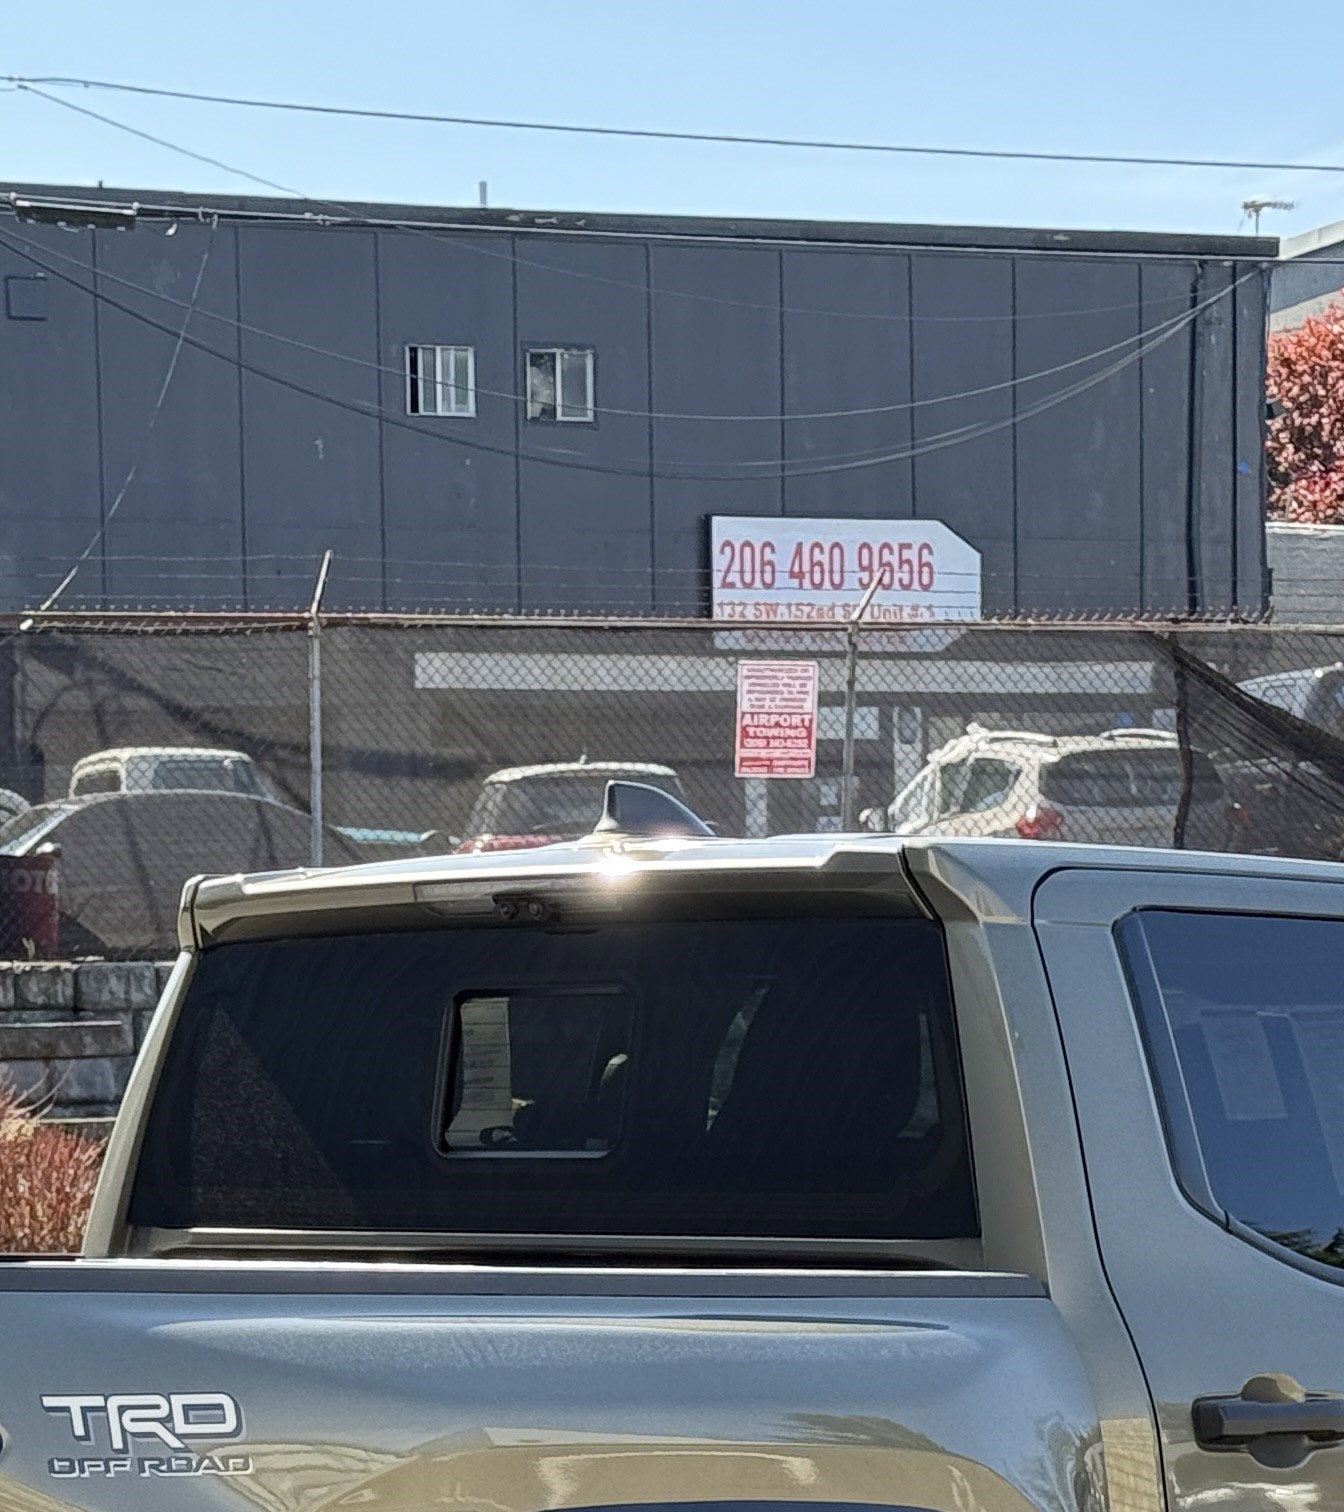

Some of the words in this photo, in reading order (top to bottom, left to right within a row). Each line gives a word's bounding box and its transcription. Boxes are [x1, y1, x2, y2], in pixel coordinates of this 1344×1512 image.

[720, 540, 776, 588] 206
[788, 541, 845, 590] 460
[858, 541, 934, 591] 9656
[742, 714, 812, 727] AIRPORT
[746, 727, 808, 738] TOWING
[40, 1392, 244, 1456] TRD
[48, 1456, 133, 1478] OFF
[137, 1455, 255, 1478] ROAD
